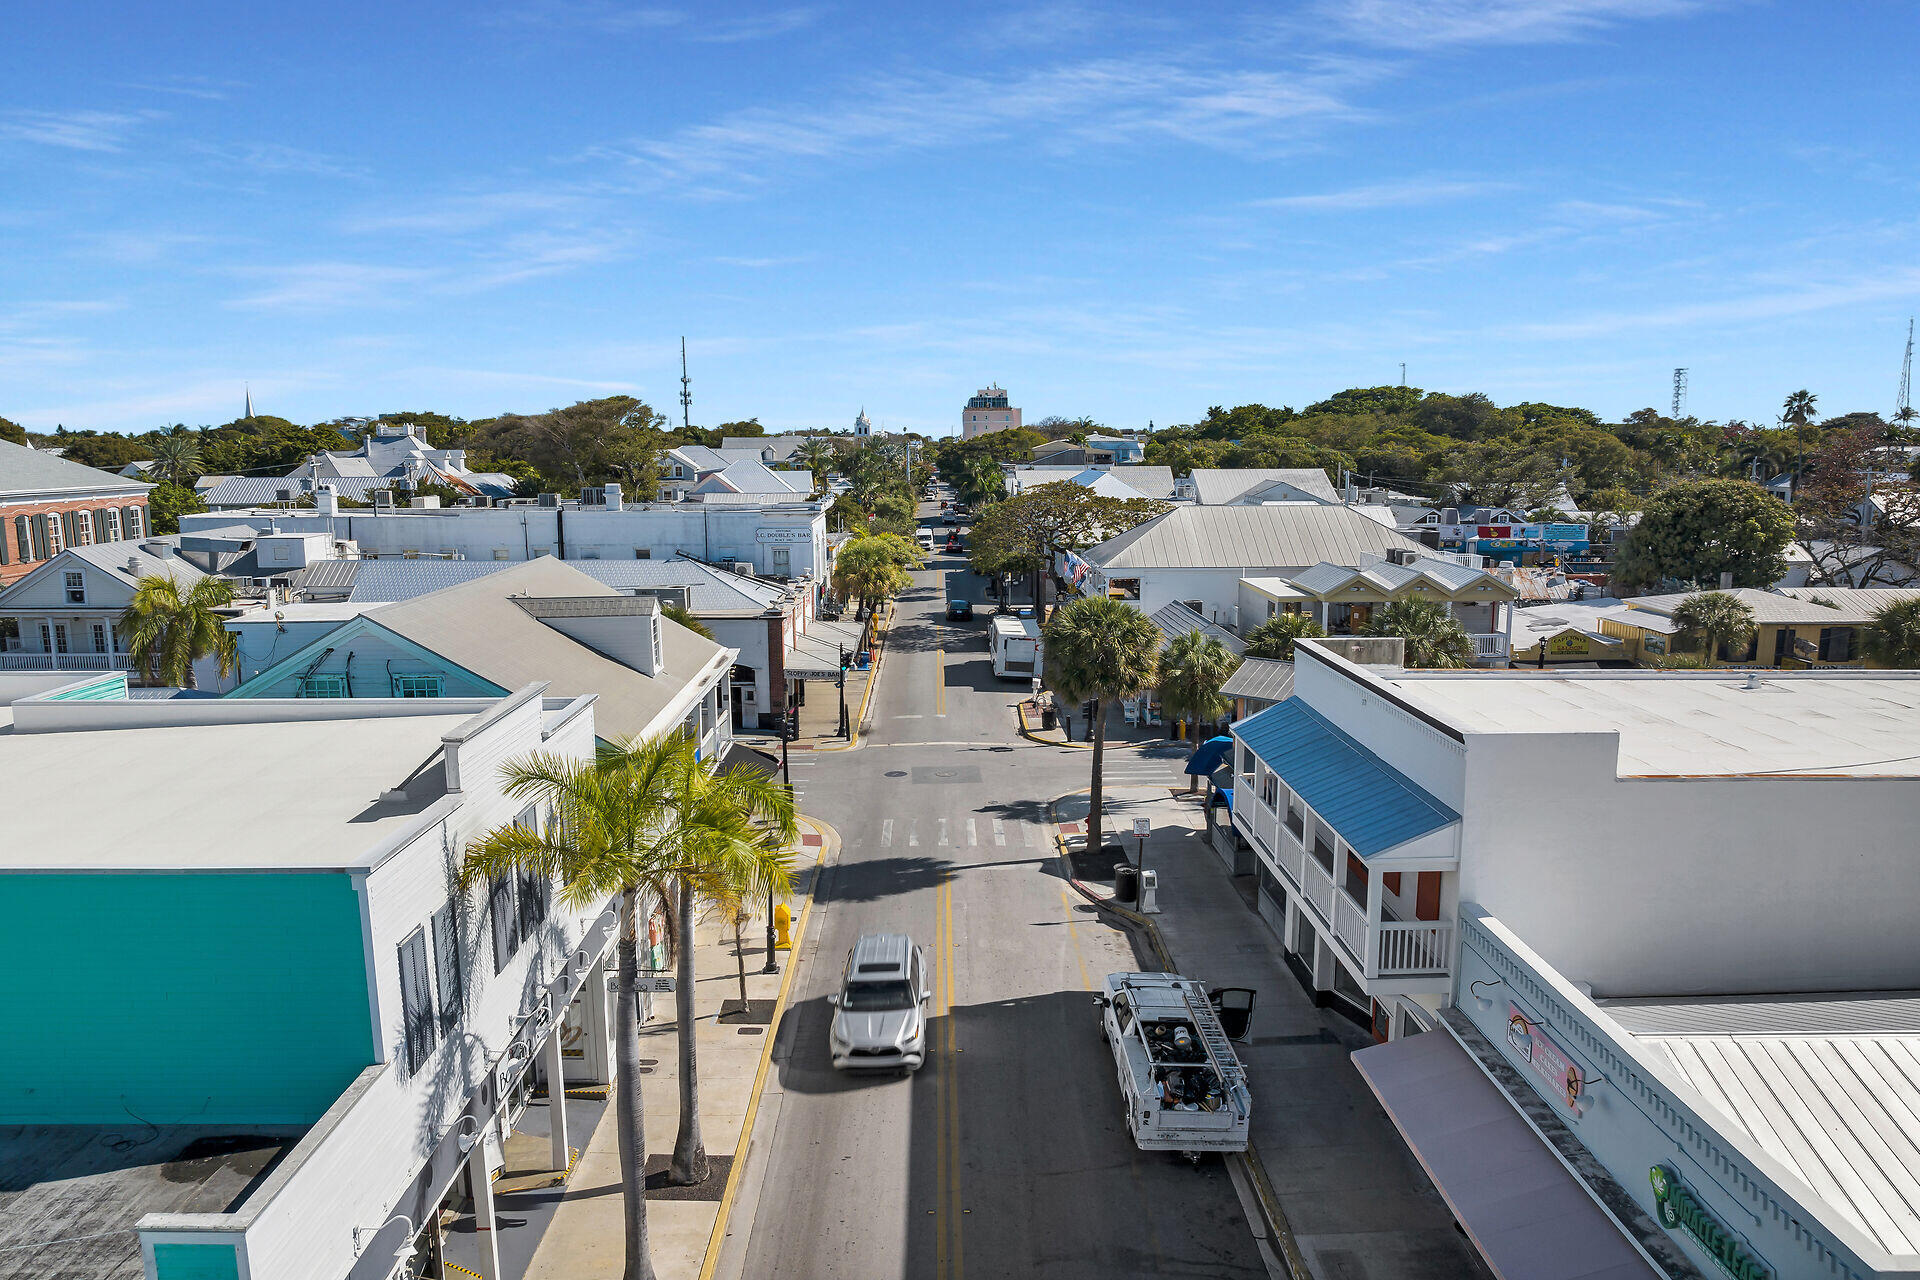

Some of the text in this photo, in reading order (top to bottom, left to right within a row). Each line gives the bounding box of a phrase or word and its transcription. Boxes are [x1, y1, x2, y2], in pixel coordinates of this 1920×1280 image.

[1544, 1047, 1565, 1072] CREAM
[1668, 1183, 1728, 1257] MIRACLE
[1681, 1222, 1712, 1259] HEALTH
